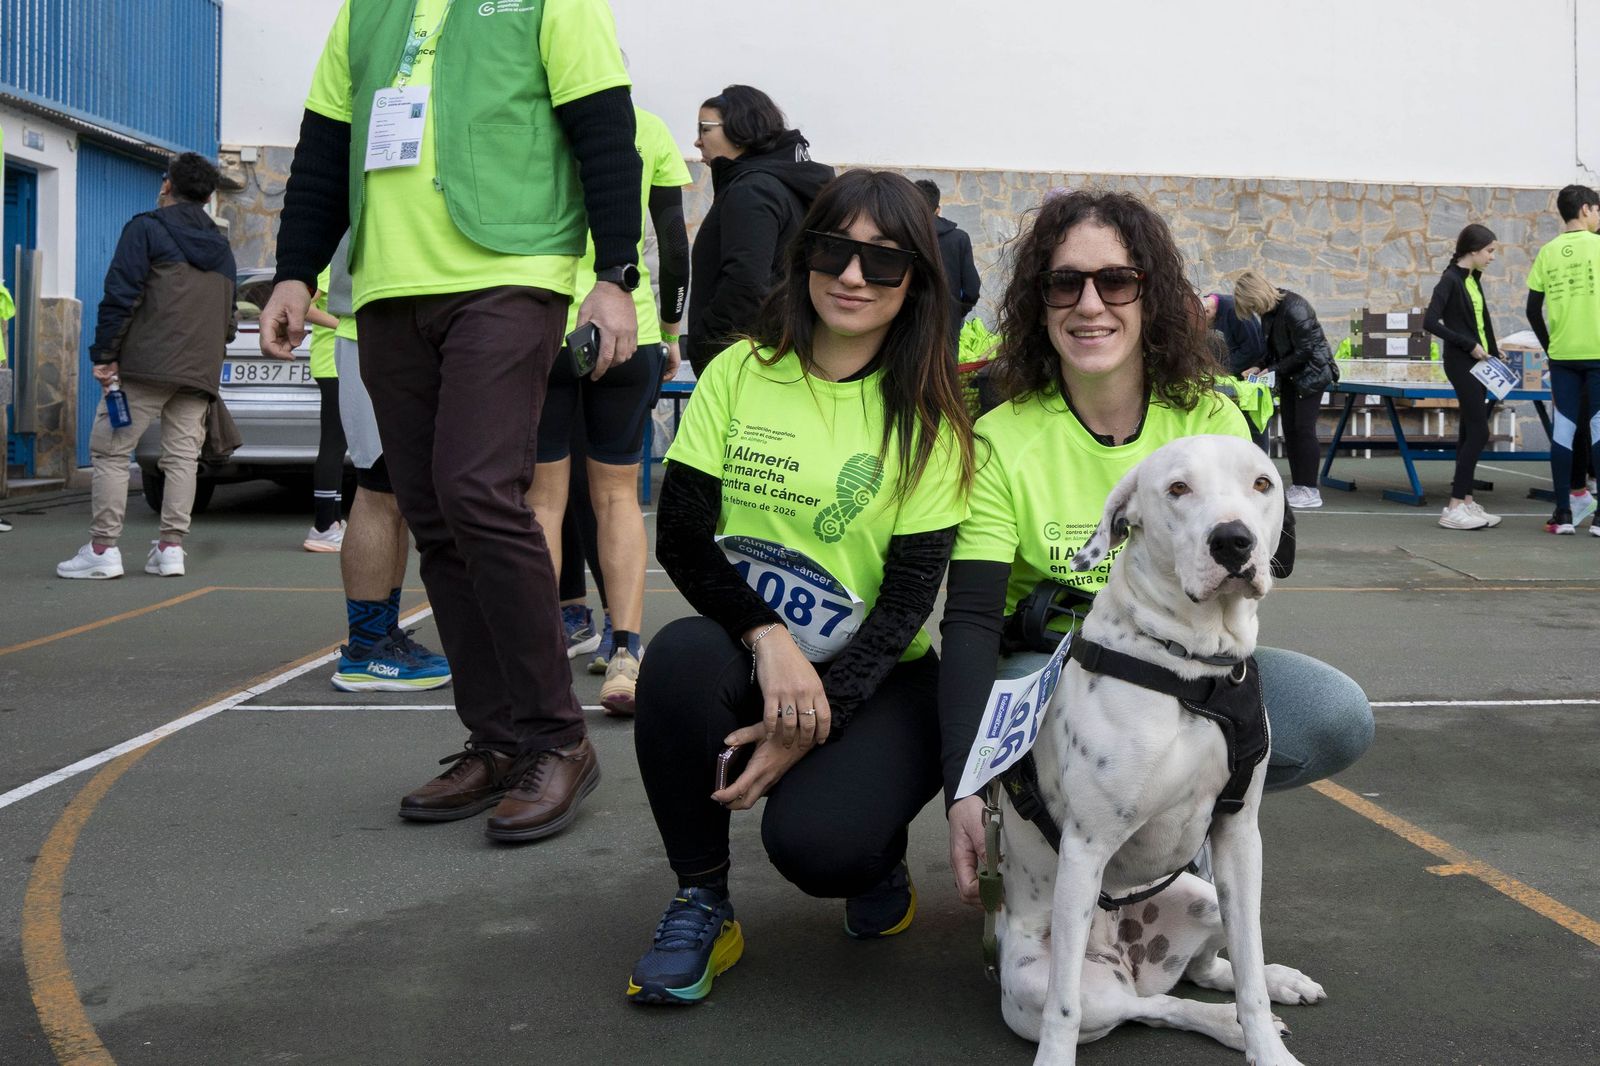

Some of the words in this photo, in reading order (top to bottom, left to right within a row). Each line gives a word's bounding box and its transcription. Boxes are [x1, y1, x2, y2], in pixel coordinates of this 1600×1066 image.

[234, 364, 283, 381] 9837
[1482, 365, 1506, 388] 371
[733, 445, 800, 473] Almería
[723, 463, 733, 473] en
[734, 464, 785, 484] marcha
[730, 495, 757, 509] febrero
[759, 502, 771, 512] de
[773, 505, 797, 518] 2026
[753, 483, 767, 496] el
[770, 487, 821, 508] cáncer
[738, 544, 776, 563] contra
[793, 563, 832, 587] cáncer
[1049, 564, 1067, 574] en
[1096, 575, 1109, 584] el
[367, 661, 400, 677] HOKA
